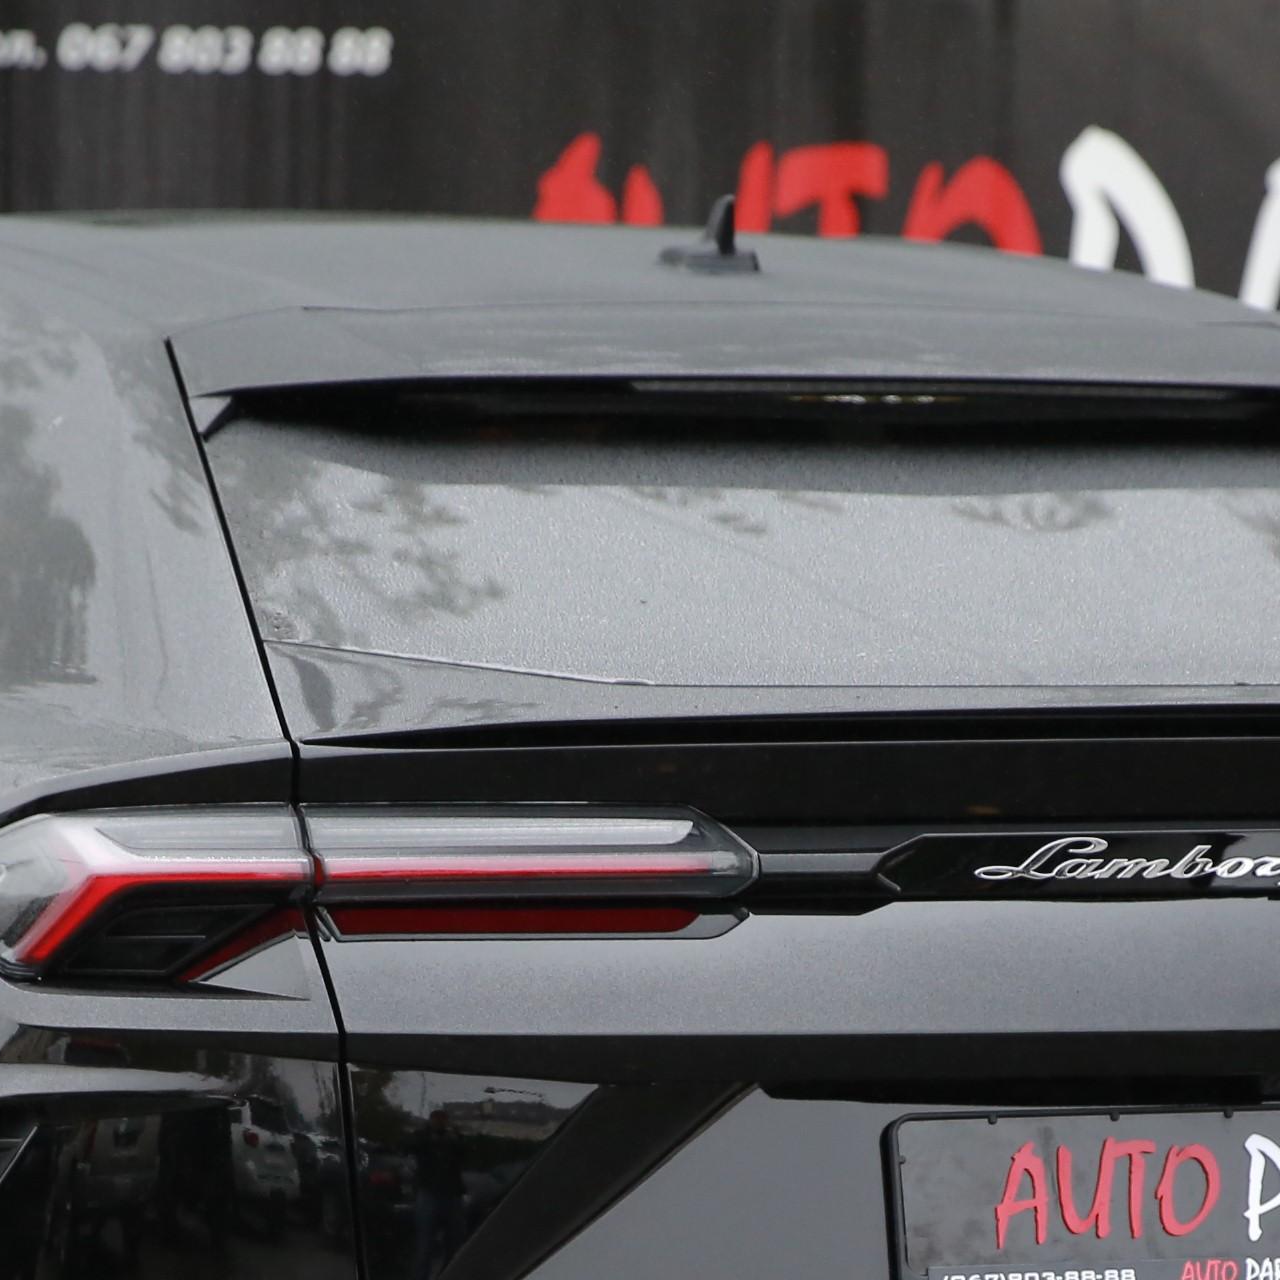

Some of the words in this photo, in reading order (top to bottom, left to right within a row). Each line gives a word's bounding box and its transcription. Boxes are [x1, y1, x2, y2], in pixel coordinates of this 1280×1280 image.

[55, 23, 155, 71] 067
[257, 26, 325, 75] 88
[327, 27, 394, 76] 88
[994, 1135, 1221, 1249] AUTO
